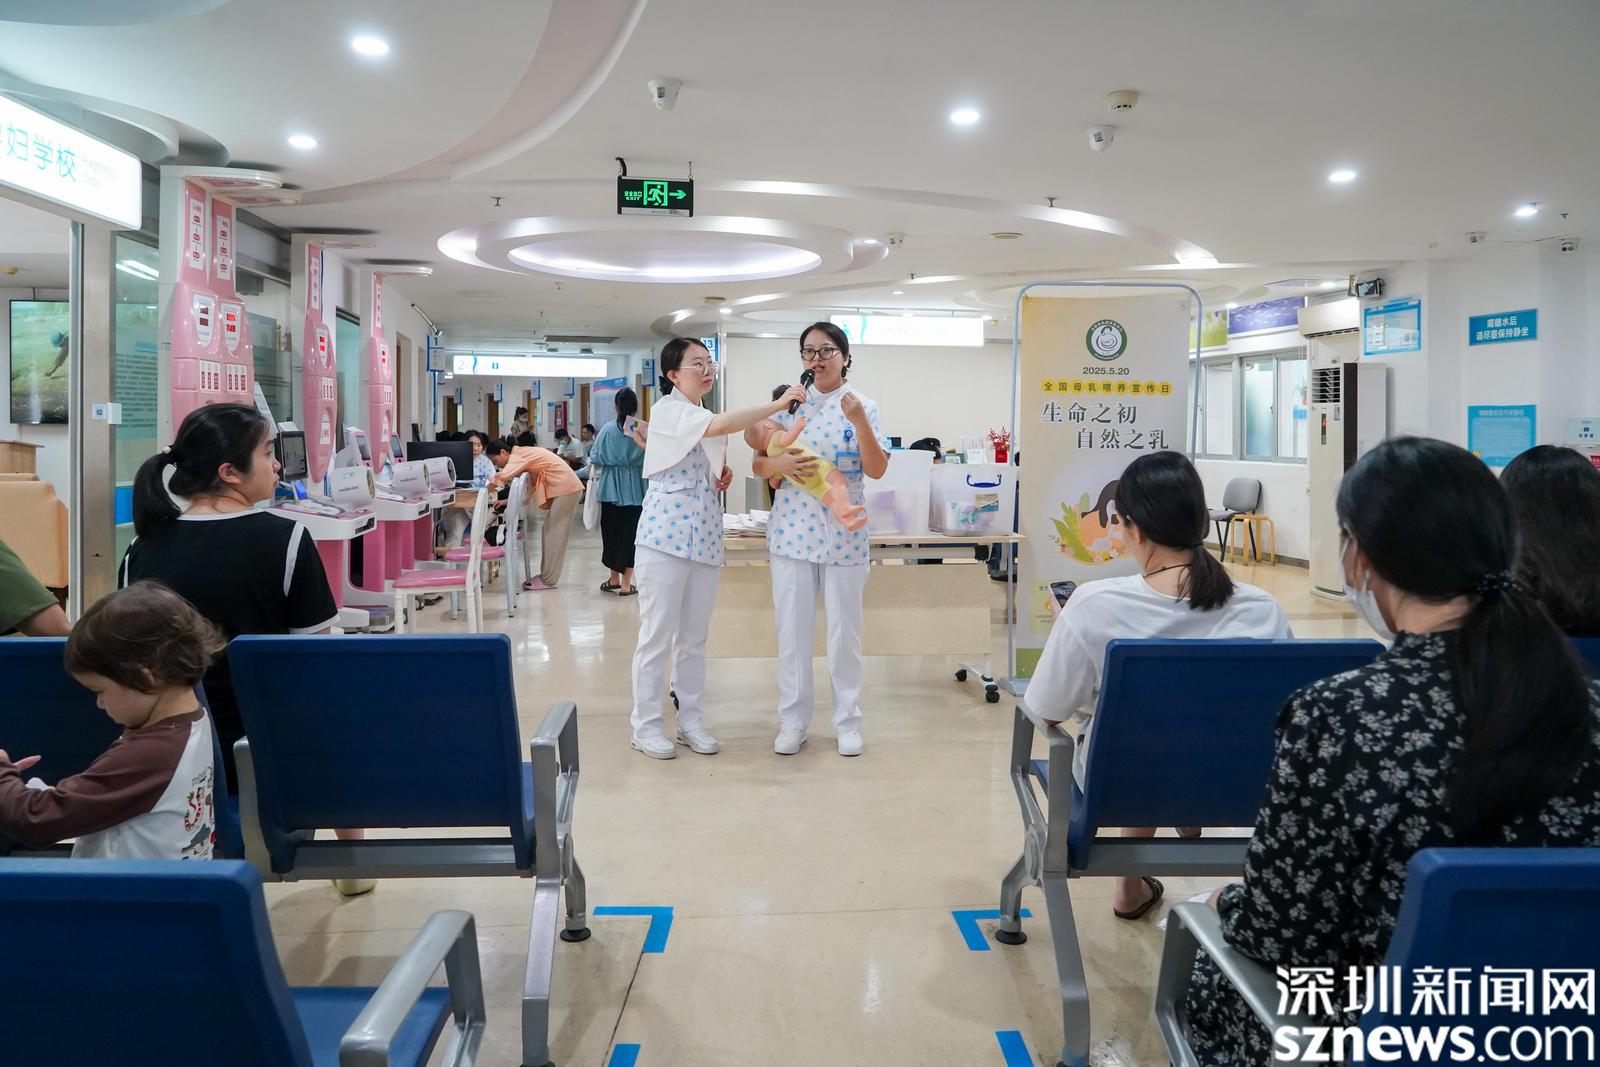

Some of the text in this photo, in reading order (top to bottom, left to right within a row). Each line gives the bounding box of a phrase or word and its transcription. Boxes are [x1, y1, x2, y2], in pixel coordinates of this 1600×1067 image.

[0, 122, 77, 182] 妇学校
[1082, 366, 1130, 376] 2025.5.20
[1043, 382, 1169, 393] 全国母乳喂养宣传日
[1042, 401, 1137, 424] 生命之初
[1077, 428, 1169, 450] 自然之乳
